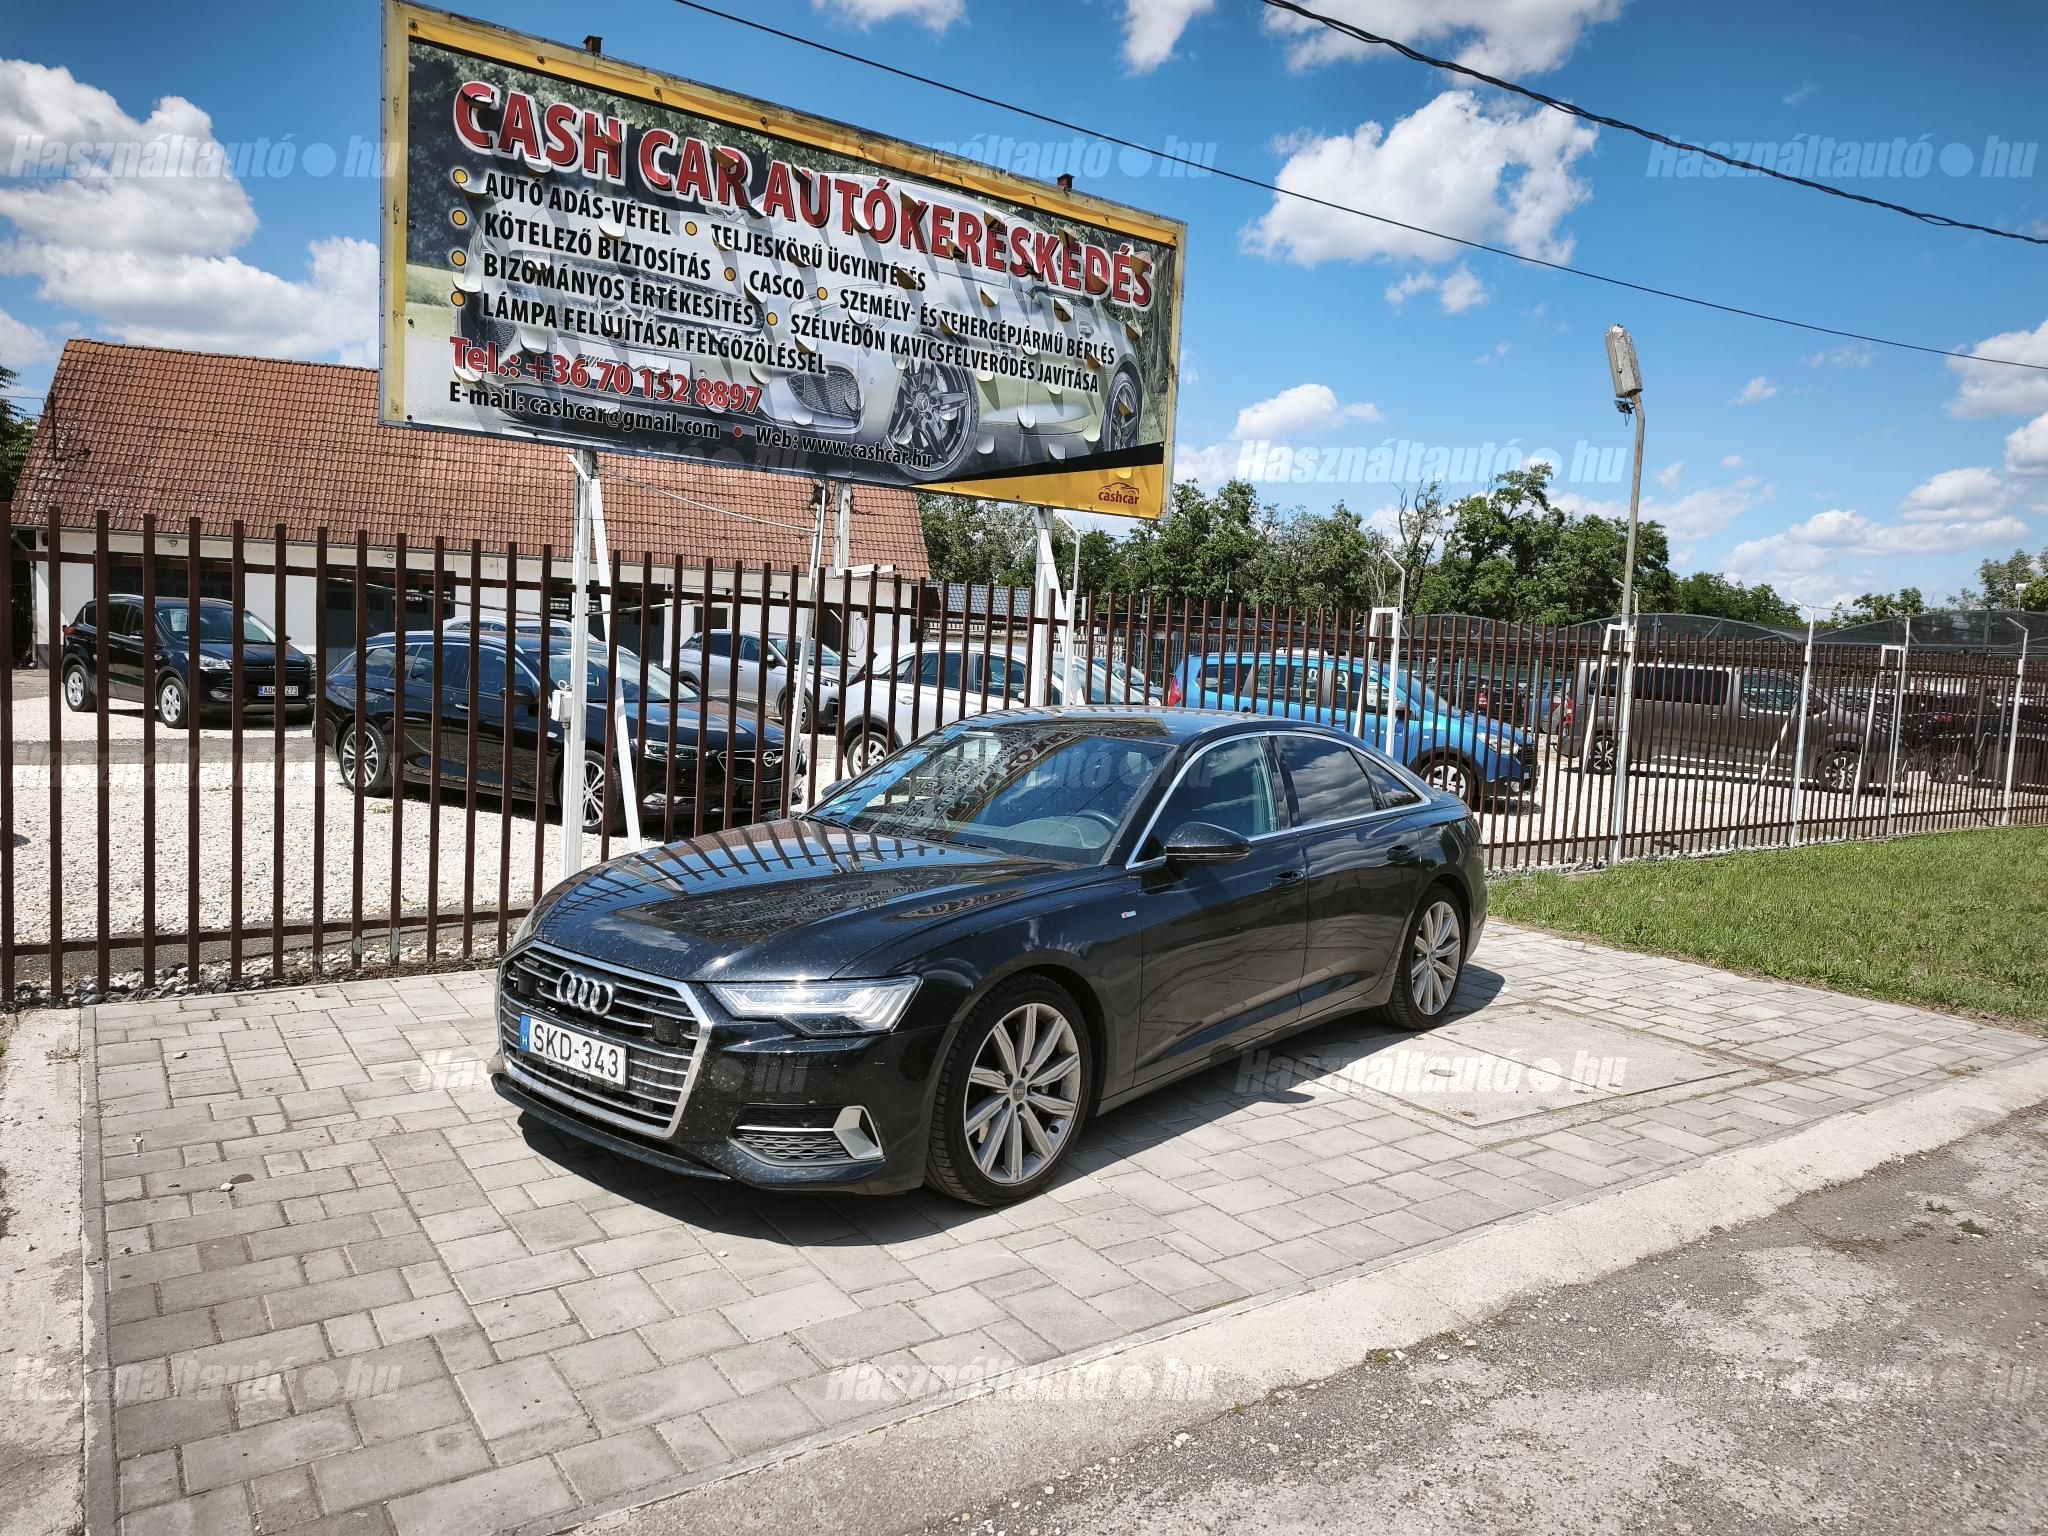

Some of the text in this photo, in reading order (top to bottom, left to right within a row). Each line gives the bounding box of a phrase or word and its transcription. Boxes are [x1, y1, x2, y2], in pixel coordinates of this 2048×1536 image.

[455, 82, 1154, 308] CASH CAR AUTÓKERESKEDÉS
[485, 172, 926, 292] AUTÓ ADÁS-VÉTEL TELJESKÖRŰ ÜGYINTÉÉS
[484, 252, 1099, 393] BIZOMÁNYOS ÉRTÉKESÍTÉS SZÉLVÉDŐN KAVICSFELVERŐDÉS JAVÍTÁSA
[485, 210, 592, 256] KÖTELEZŐ
[598, 236, 711, 281] BIZTOSÍTÁS
[749, 270, 805, 300] CASCO
[840, 289, 916, 322] SZEMÉLY-
[920, 302, 938, 328] ÉS
[941, 310, 1063, 355] TEHERGÉPJÁRMŰ
[449, 336, 763, 414] Tel.: +36 70 152 8897
[483, 291, 827, 375] LÁMPA FELÚJÍTÁSA FELGŐZÖLÉSSEL
[449, 381, 932, 469] E-mail: cashcar@gmail.com Web: www.cashcar.hu
[1098, 490, 1139, 505] cashcar
[285, 686, 298, 694] 273
[533, 1023, 619, 1079] SKD-343
